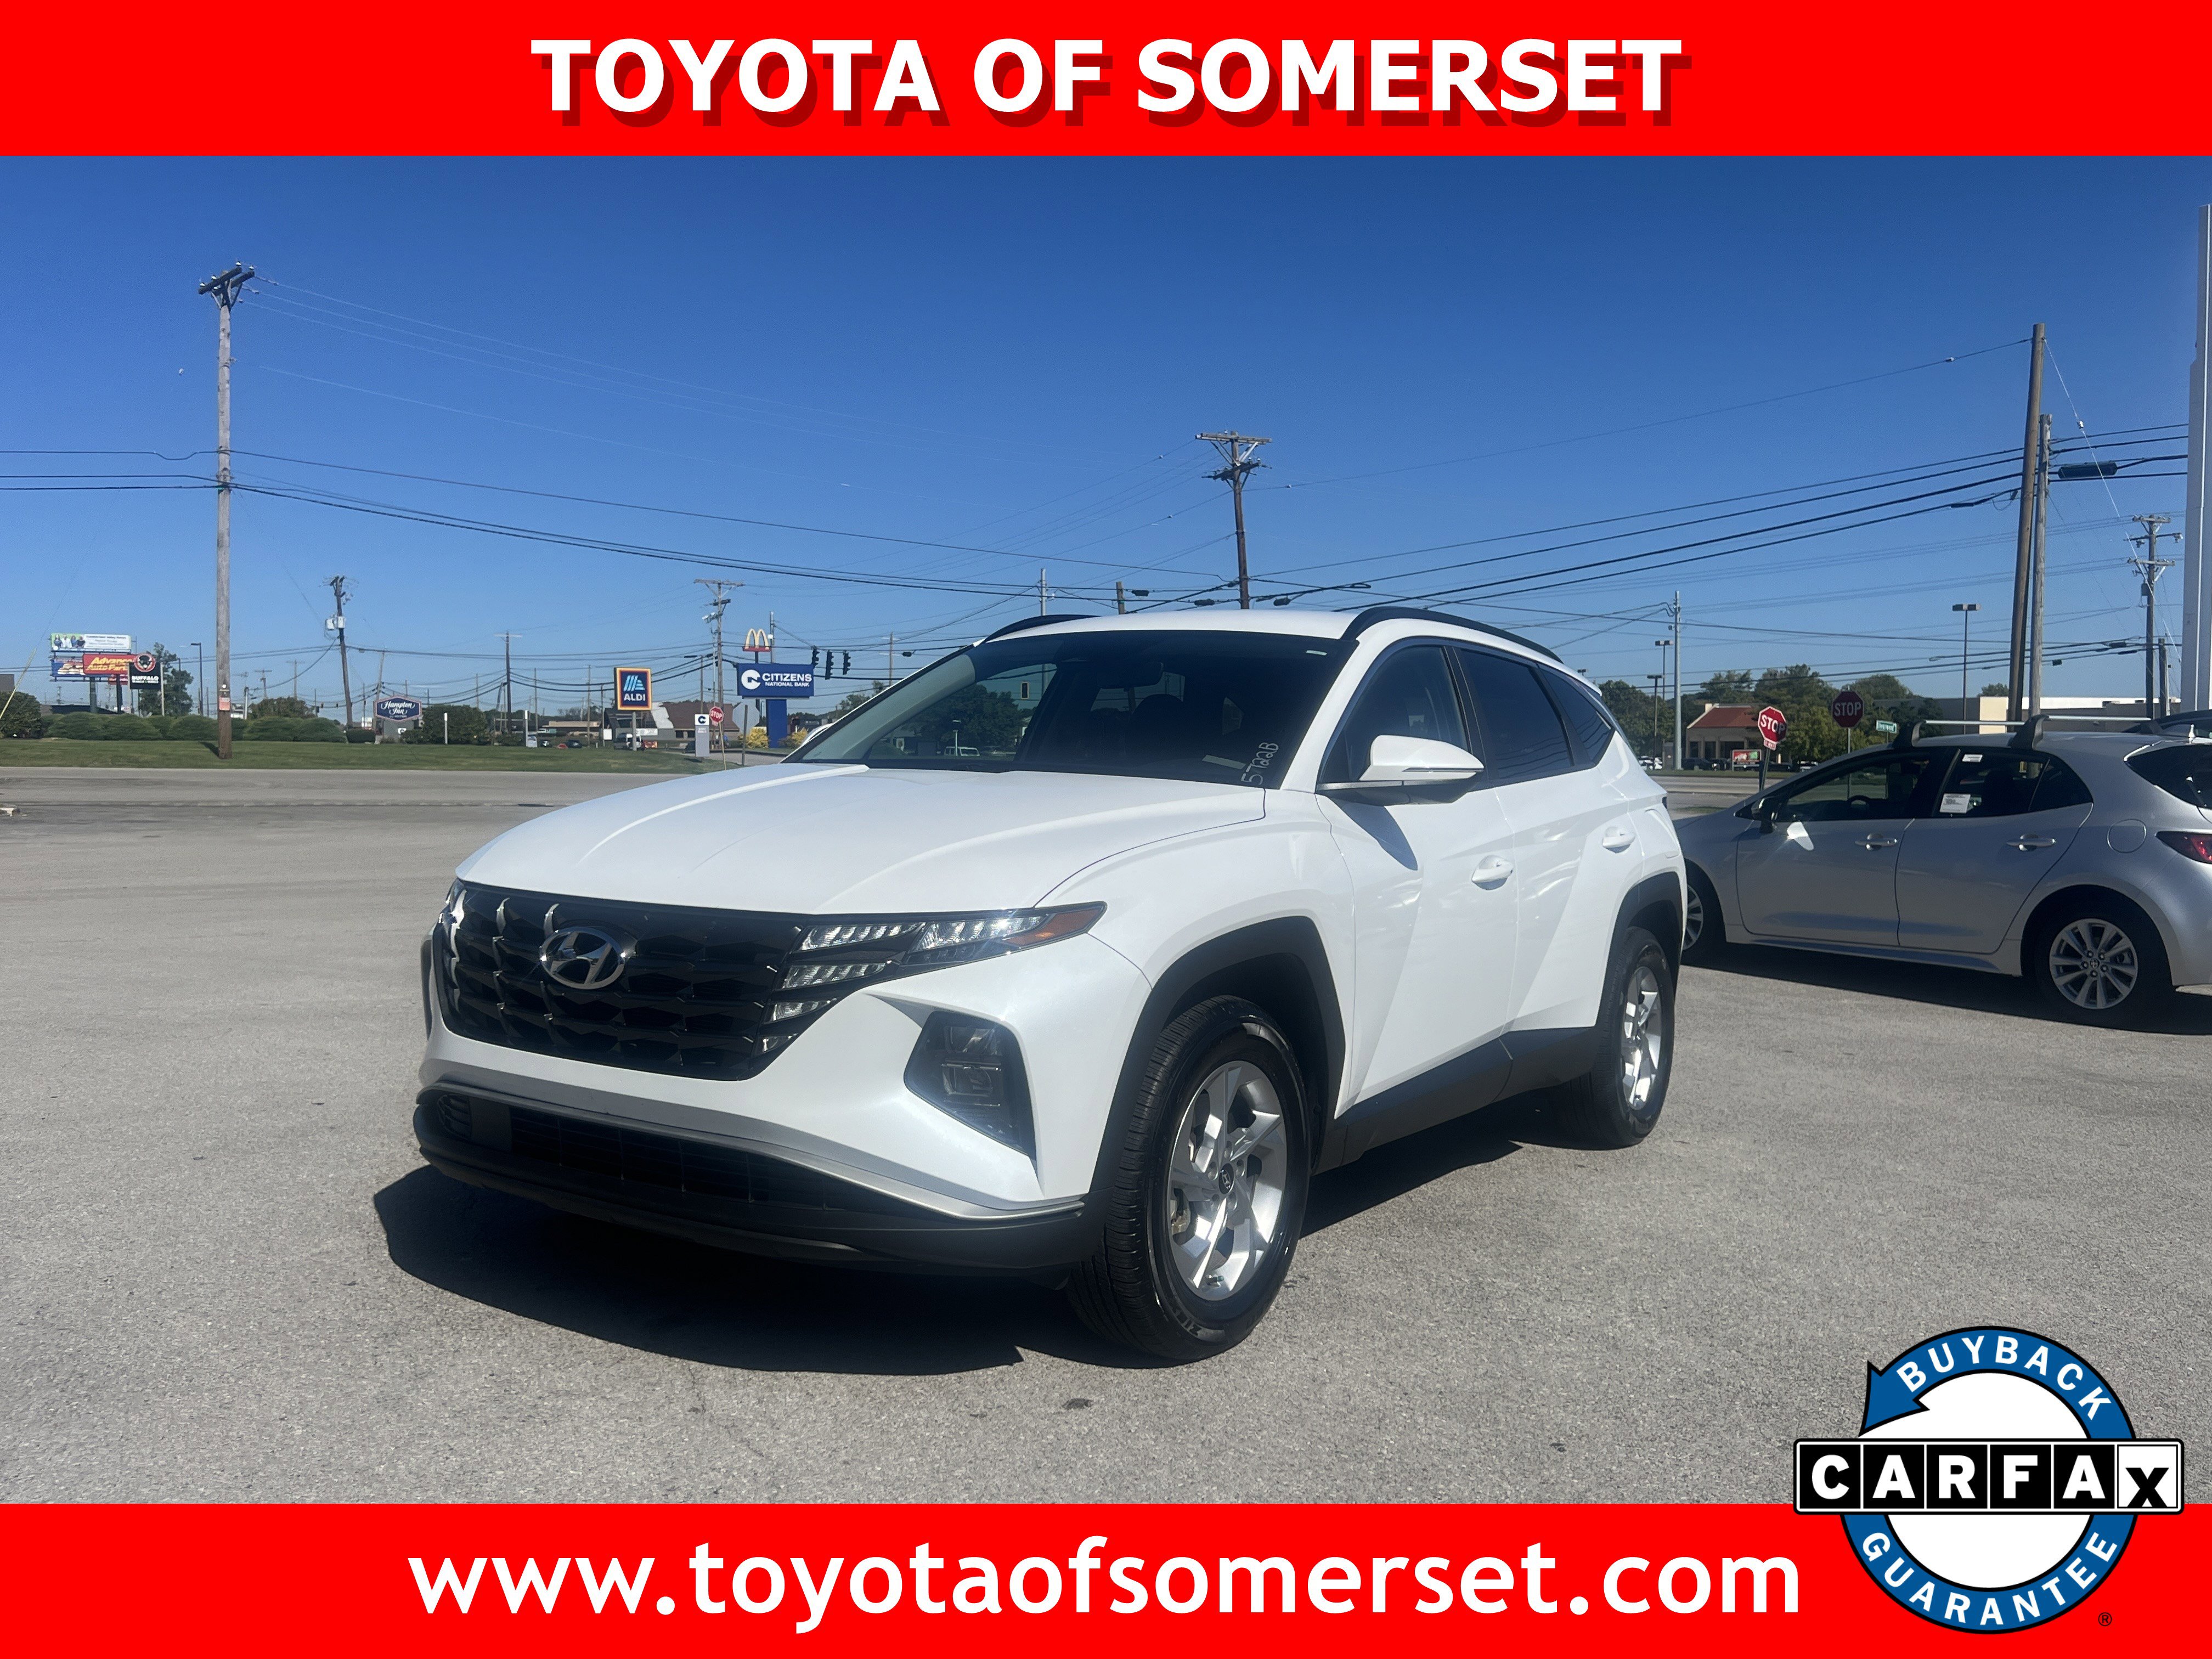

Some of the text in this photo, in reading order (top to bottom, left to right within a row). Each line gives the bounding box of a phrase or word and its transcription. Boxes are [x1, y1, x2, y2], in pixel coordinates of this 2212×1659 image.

[762, 673, 812, 682] CITIZENS
[380, 701, 415, 710] Hampton
[1834, 702, 1861, 717] STOP
[710, 710, 723, 719] STOP
[1760, 714, 1786, 735] STOP
